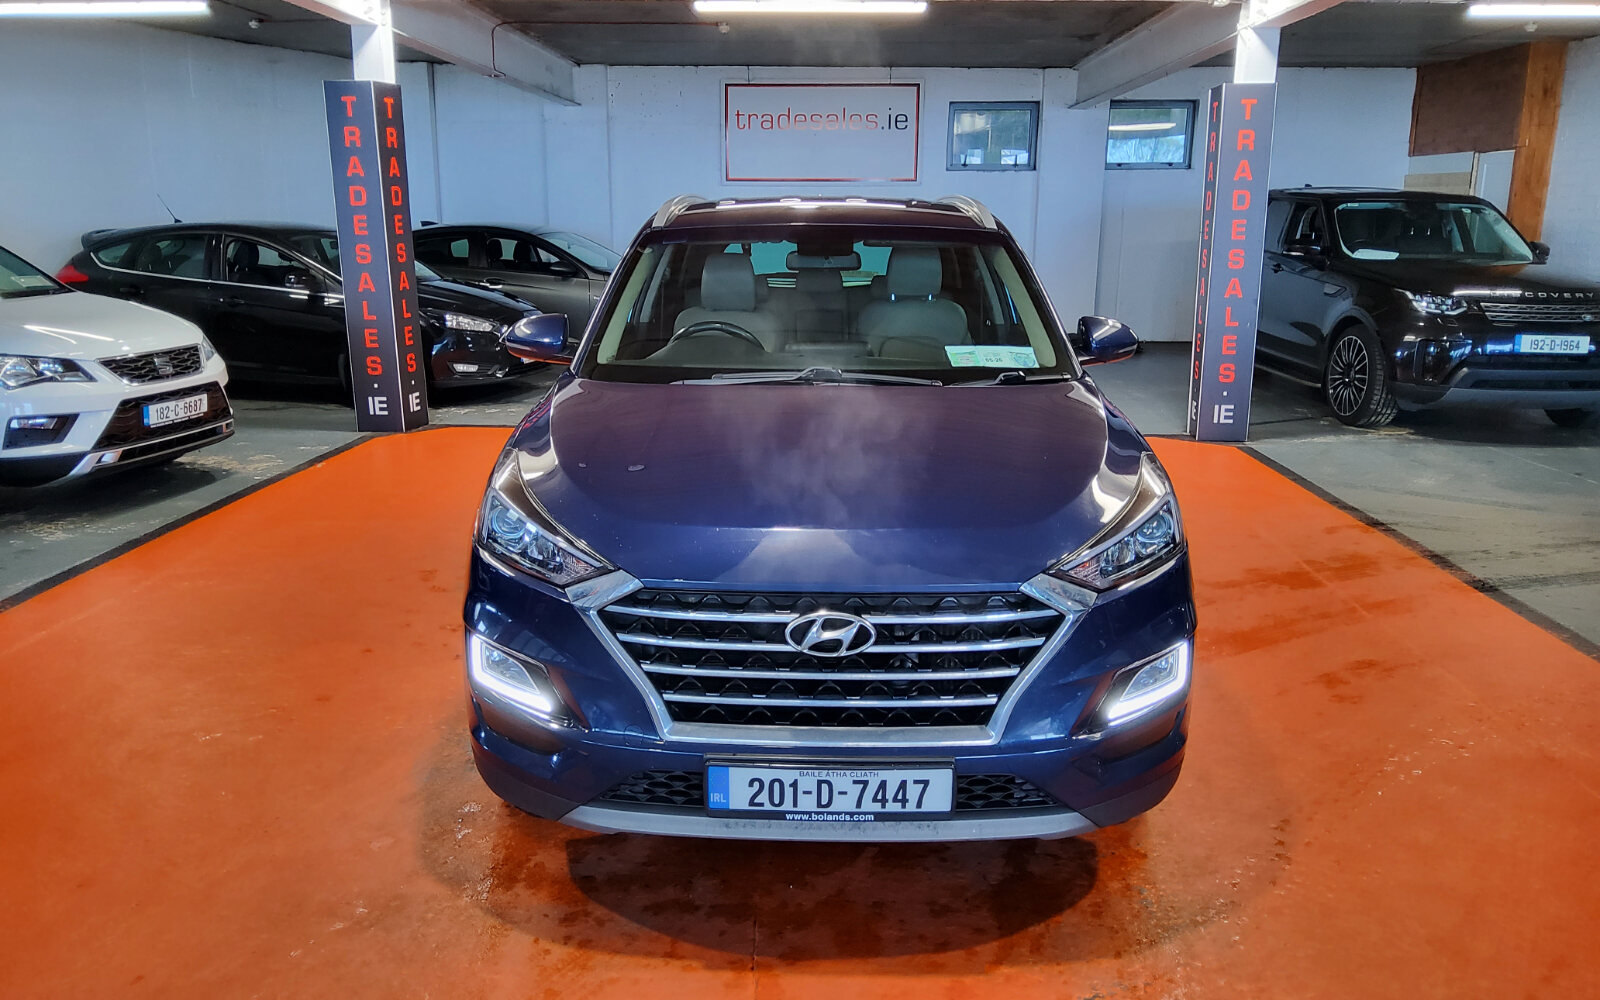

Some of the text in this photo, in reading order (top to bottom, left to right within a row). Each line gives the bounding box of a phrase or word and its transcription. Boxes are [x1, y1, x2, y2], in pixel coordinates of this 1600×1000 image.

[735, 107, 908, 130] tradesales.ie
[1529, 339, 1581, 351] 192-D-1964
[155, 398, 203, 421] 182-C-6687
[799, 770, 823, 778] BAILE
[710, 792, 727, 803] IRL
[748, 777, 930, 809] 201-D-7447
[785, 813, 875, 821] www.bolands.com
